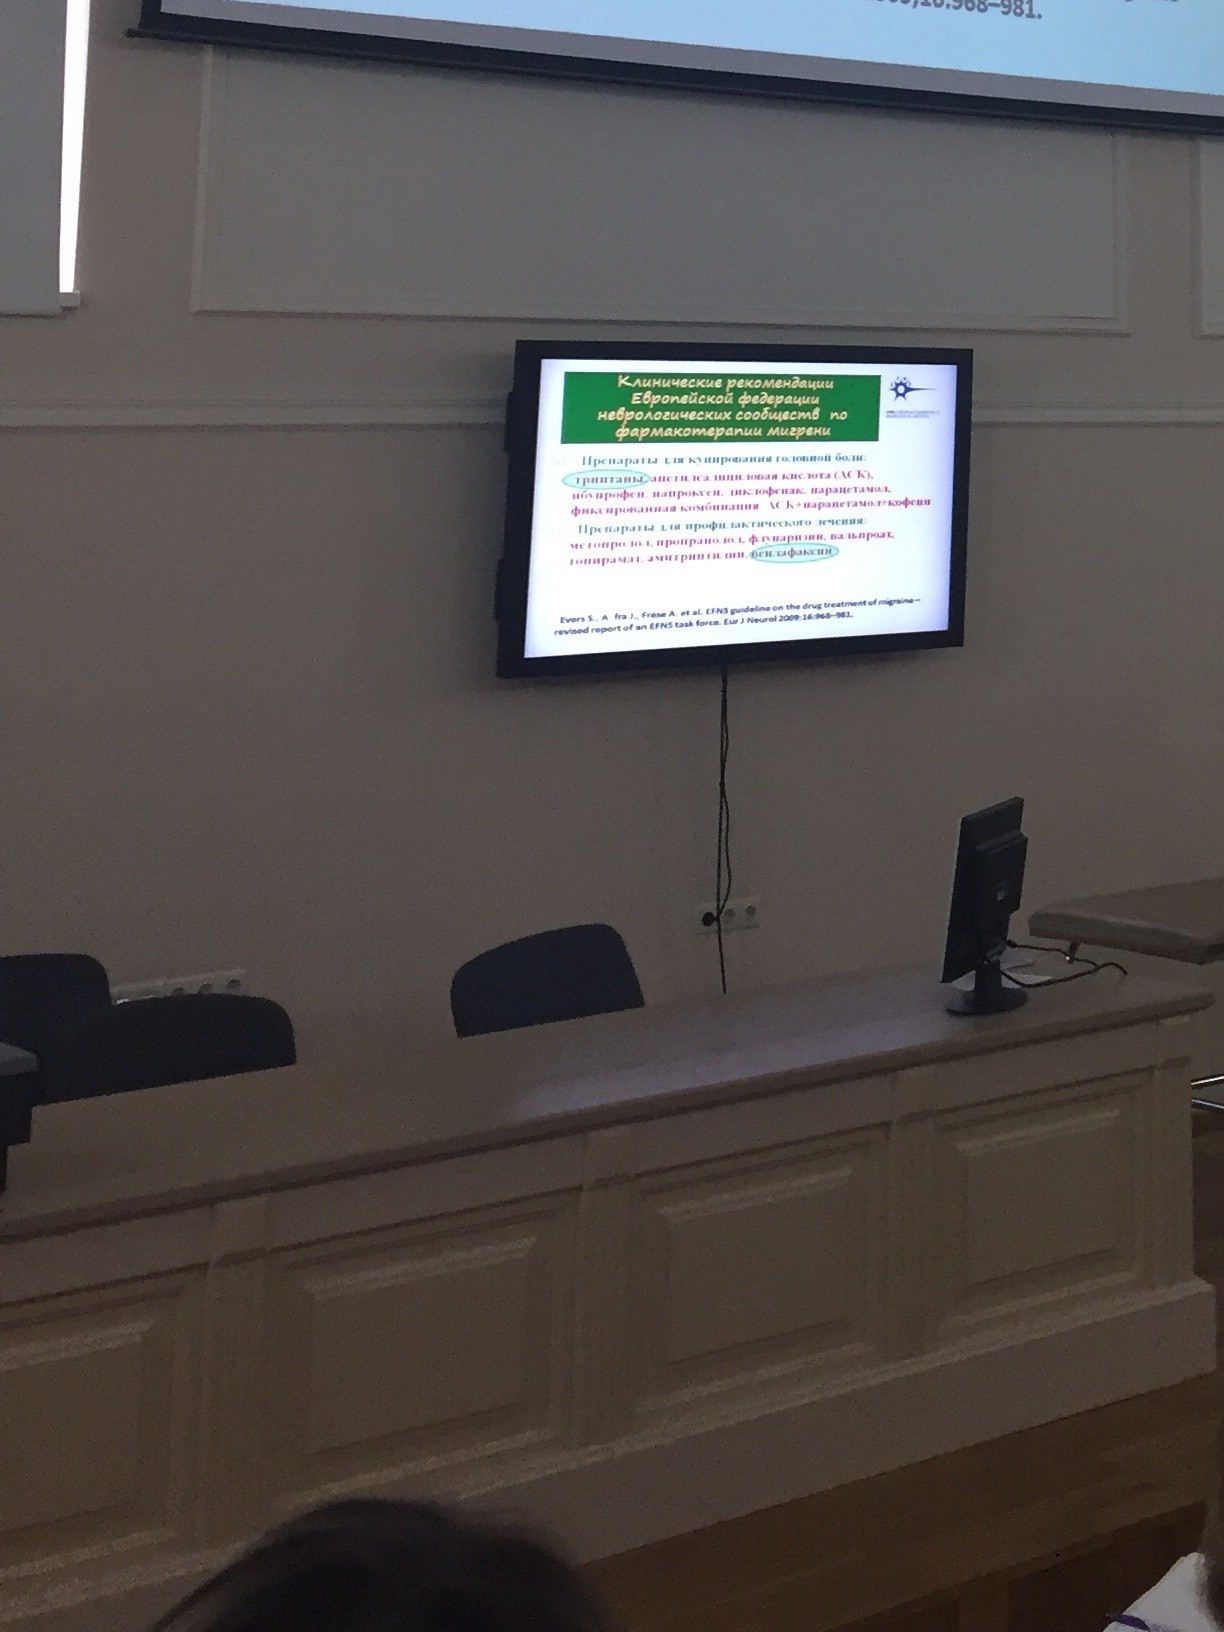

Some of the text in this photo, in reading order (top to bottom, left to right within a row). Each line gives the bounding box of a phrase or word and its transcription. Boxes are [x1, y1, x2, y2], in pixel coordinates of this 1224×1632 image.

[618, 375, 834, 392] Клинические рекомендации
[631, 390, 819, 408] Европейской федерации
[597, 406, 848, 426] неврологических сообществ по
[615, 423, 831, 441] фармакотерапии мигрени
[560, 616, 585, 624] Evers
[730, 605, 770, 615] guideline
[786, 603, 801, 611] the
[802, 602, 822, 610] drug
[824, 599, 866, 608] treatment
[868, 598, 877, 606] of
[878, 597, 913, 606] migraine
[554, 626, 589, 636] revised
[591, 625, 621, 634] report
[675, 620, 693, 628] task
[747, 615, 777, 624] Neurol
